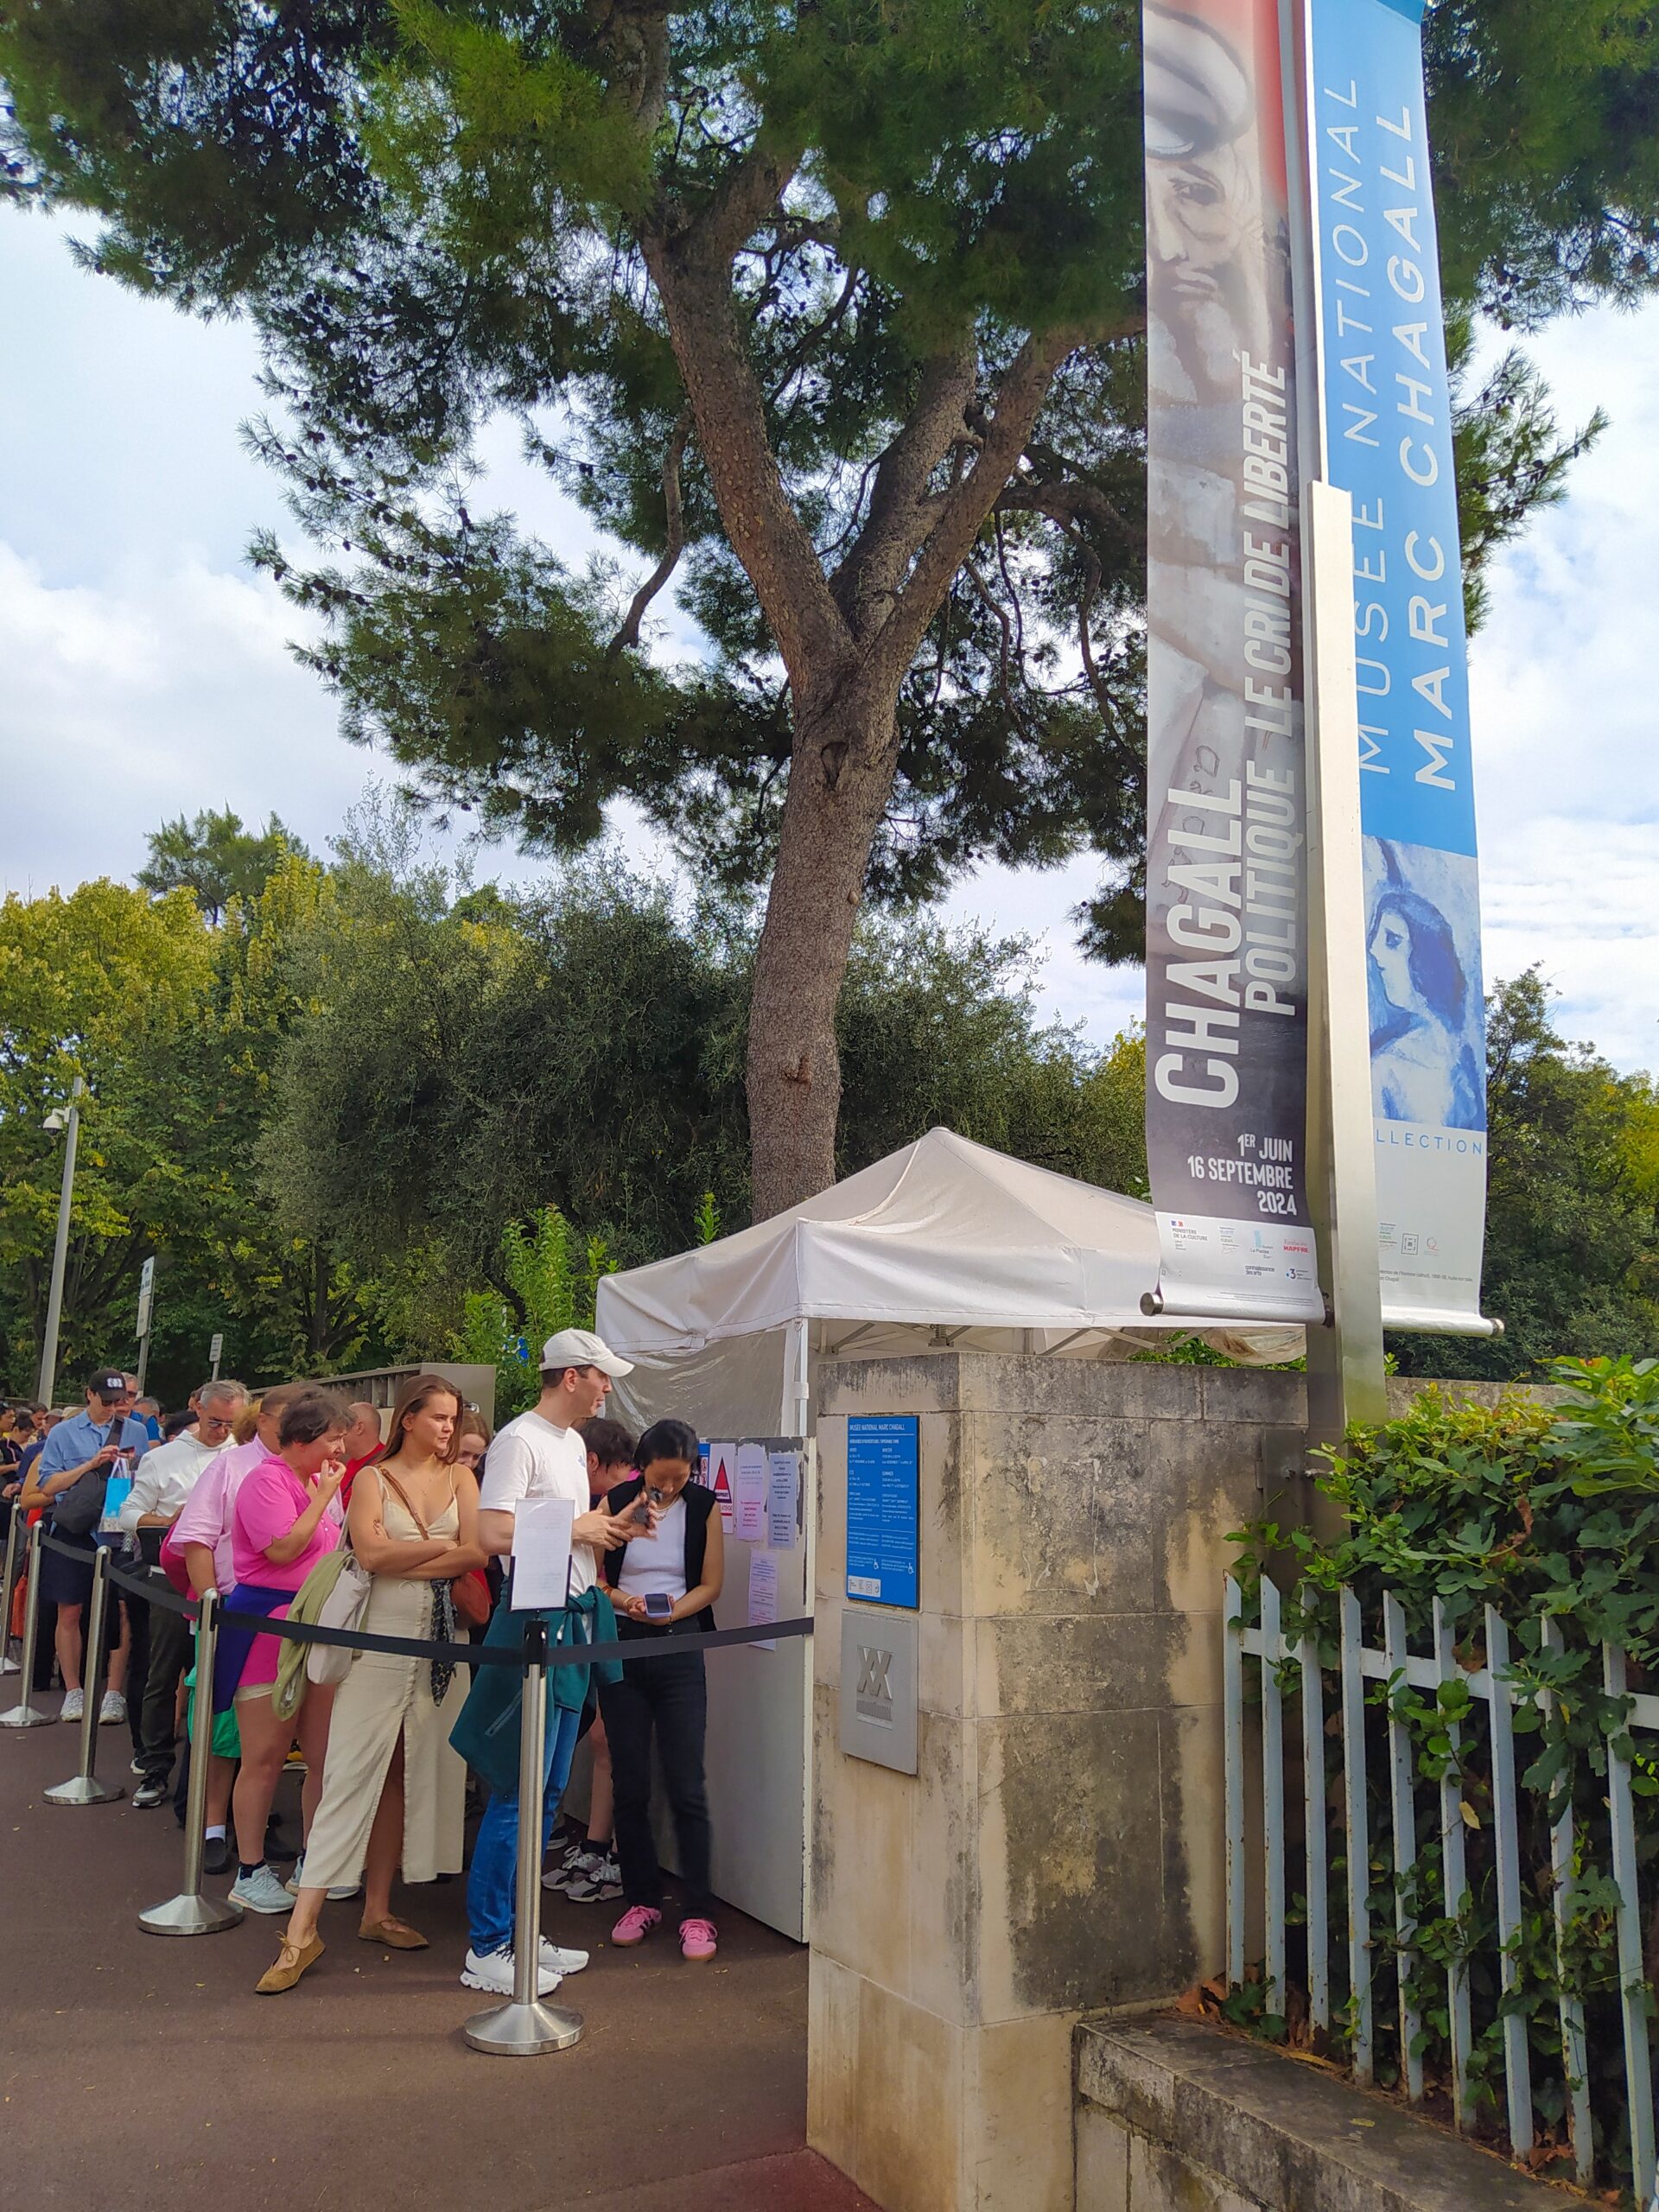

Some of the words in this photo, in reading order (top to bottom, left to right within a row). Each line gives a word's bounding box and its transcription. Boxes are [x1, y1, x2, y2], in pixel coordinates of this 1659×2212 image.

[1324, 79, 1380, 448] NATIONAL
[1376, 105, 1439, 486] CHAGALL
[1232, 350, 1289, 530] LIBERTÉ
[1243, 531, 1290, 597] DE
[1243, 597, 1292, 676] CRI
[1404, 530, 1456, 791] MARC
[1244, 677, 1293, 737] LE
[1244, 760, 1303, 1016] POLITIQUE
[1154, 779, 1242, 1109] CHAGALL
[1187, 1155, 1205, 1179] 16
[1208, 1157, 1294, 1190] SEPTEMBRE
[1259, 1137, 1293, 1163] JUIN
[1376, 1128, 1482, 1155] LLECTION
[1257, 1191, 1297, 1216] 2024
[1283, 1245, 1309, 1254] MAPFRE
